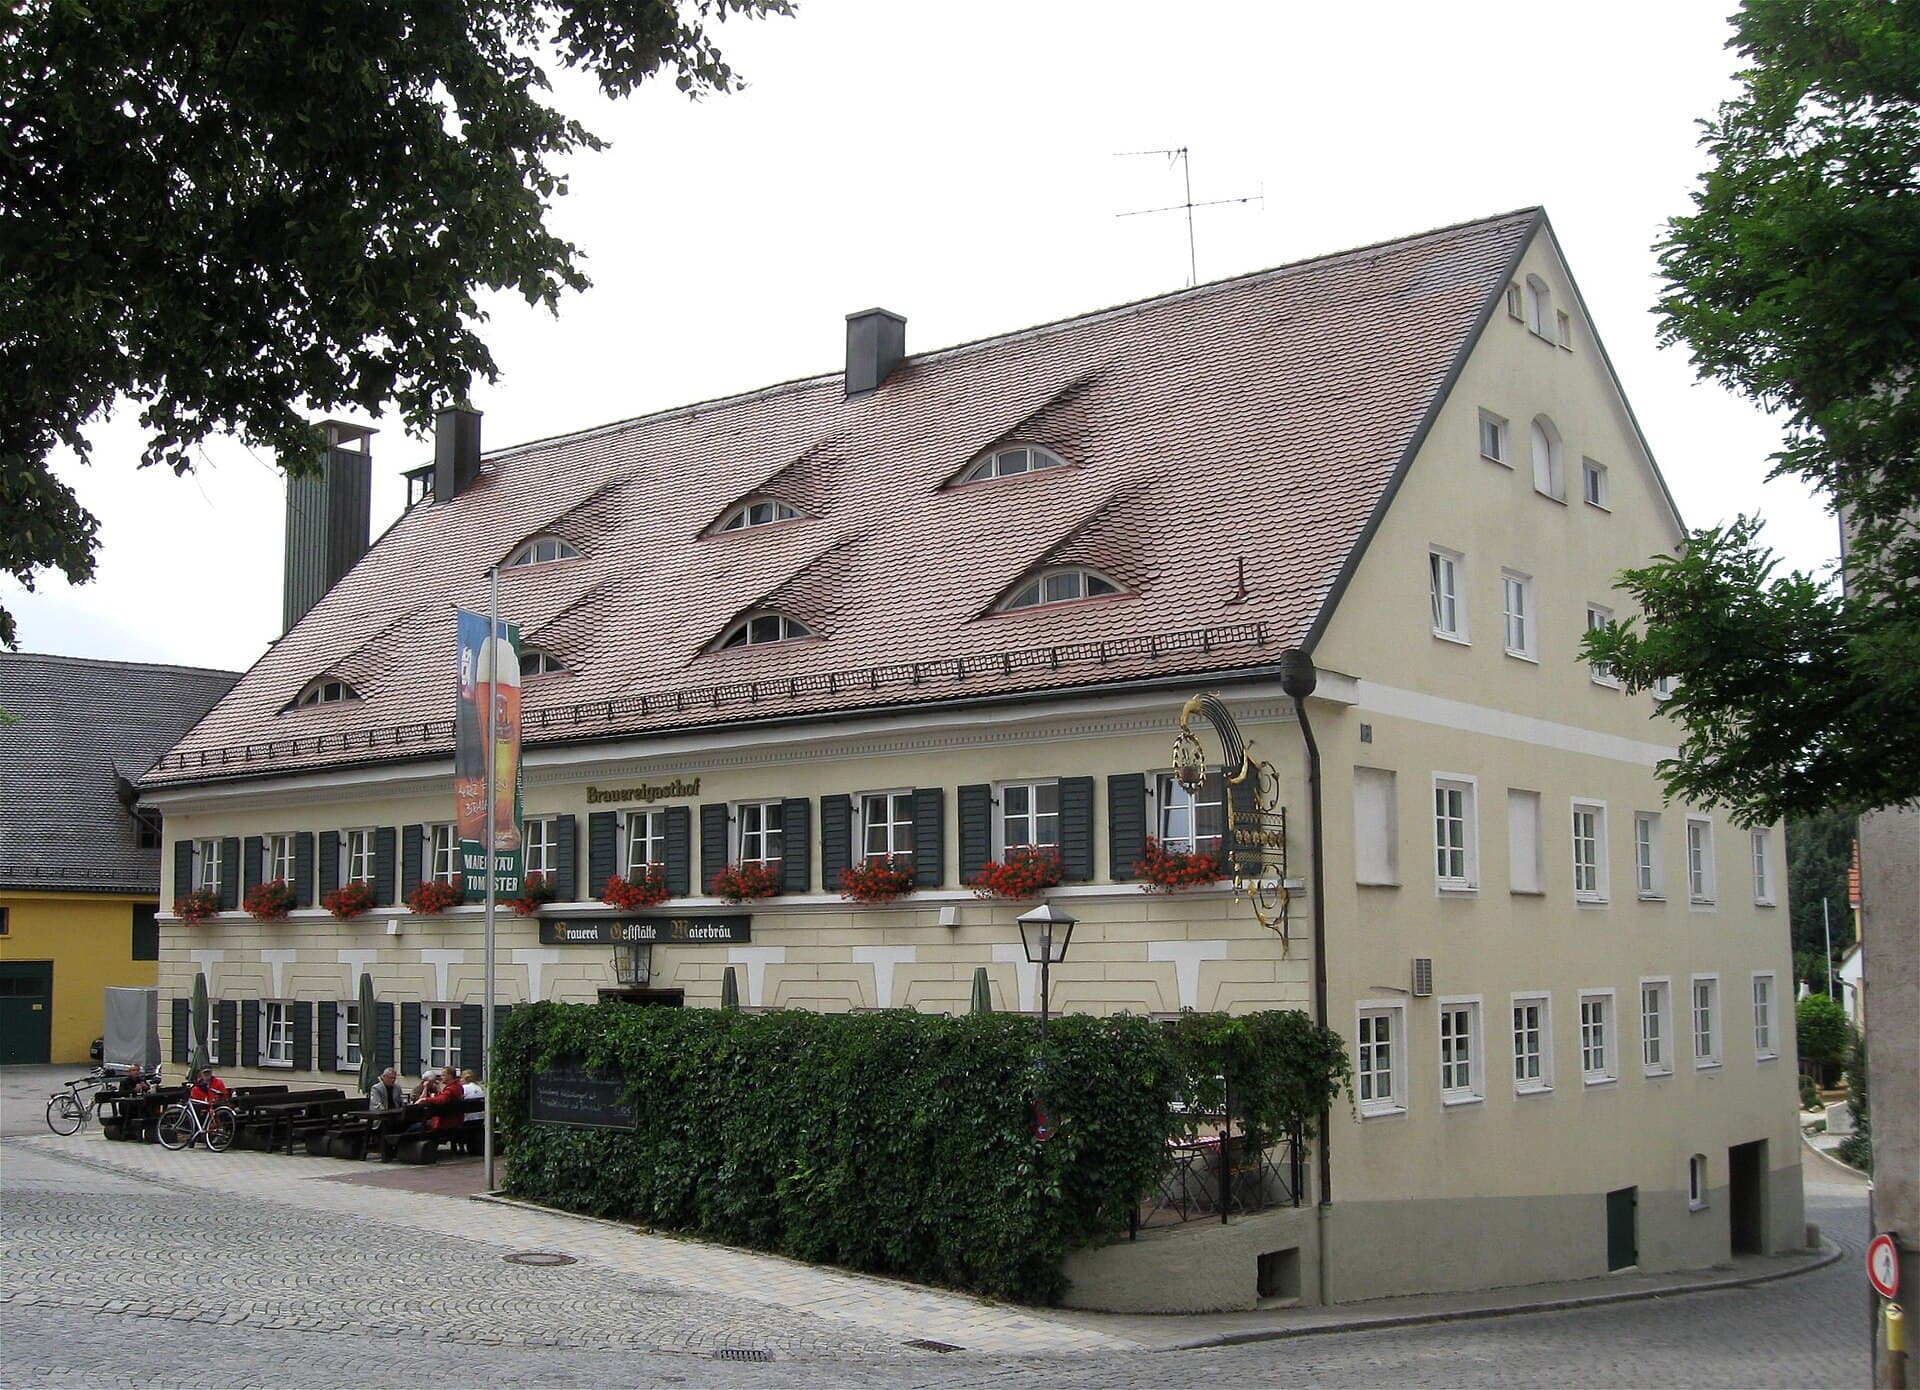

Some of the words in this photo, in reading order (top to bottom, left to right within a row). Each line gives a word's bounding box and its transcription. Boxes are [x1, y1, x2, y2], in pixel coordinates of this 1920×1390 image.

[586, 777, 700, 804] Brauereigasthof
[466, 875, 519, 892] TOMSTER
[554, 921, 599, 941] Brauerei
[671, 919, 732, 939] Maierbräu
